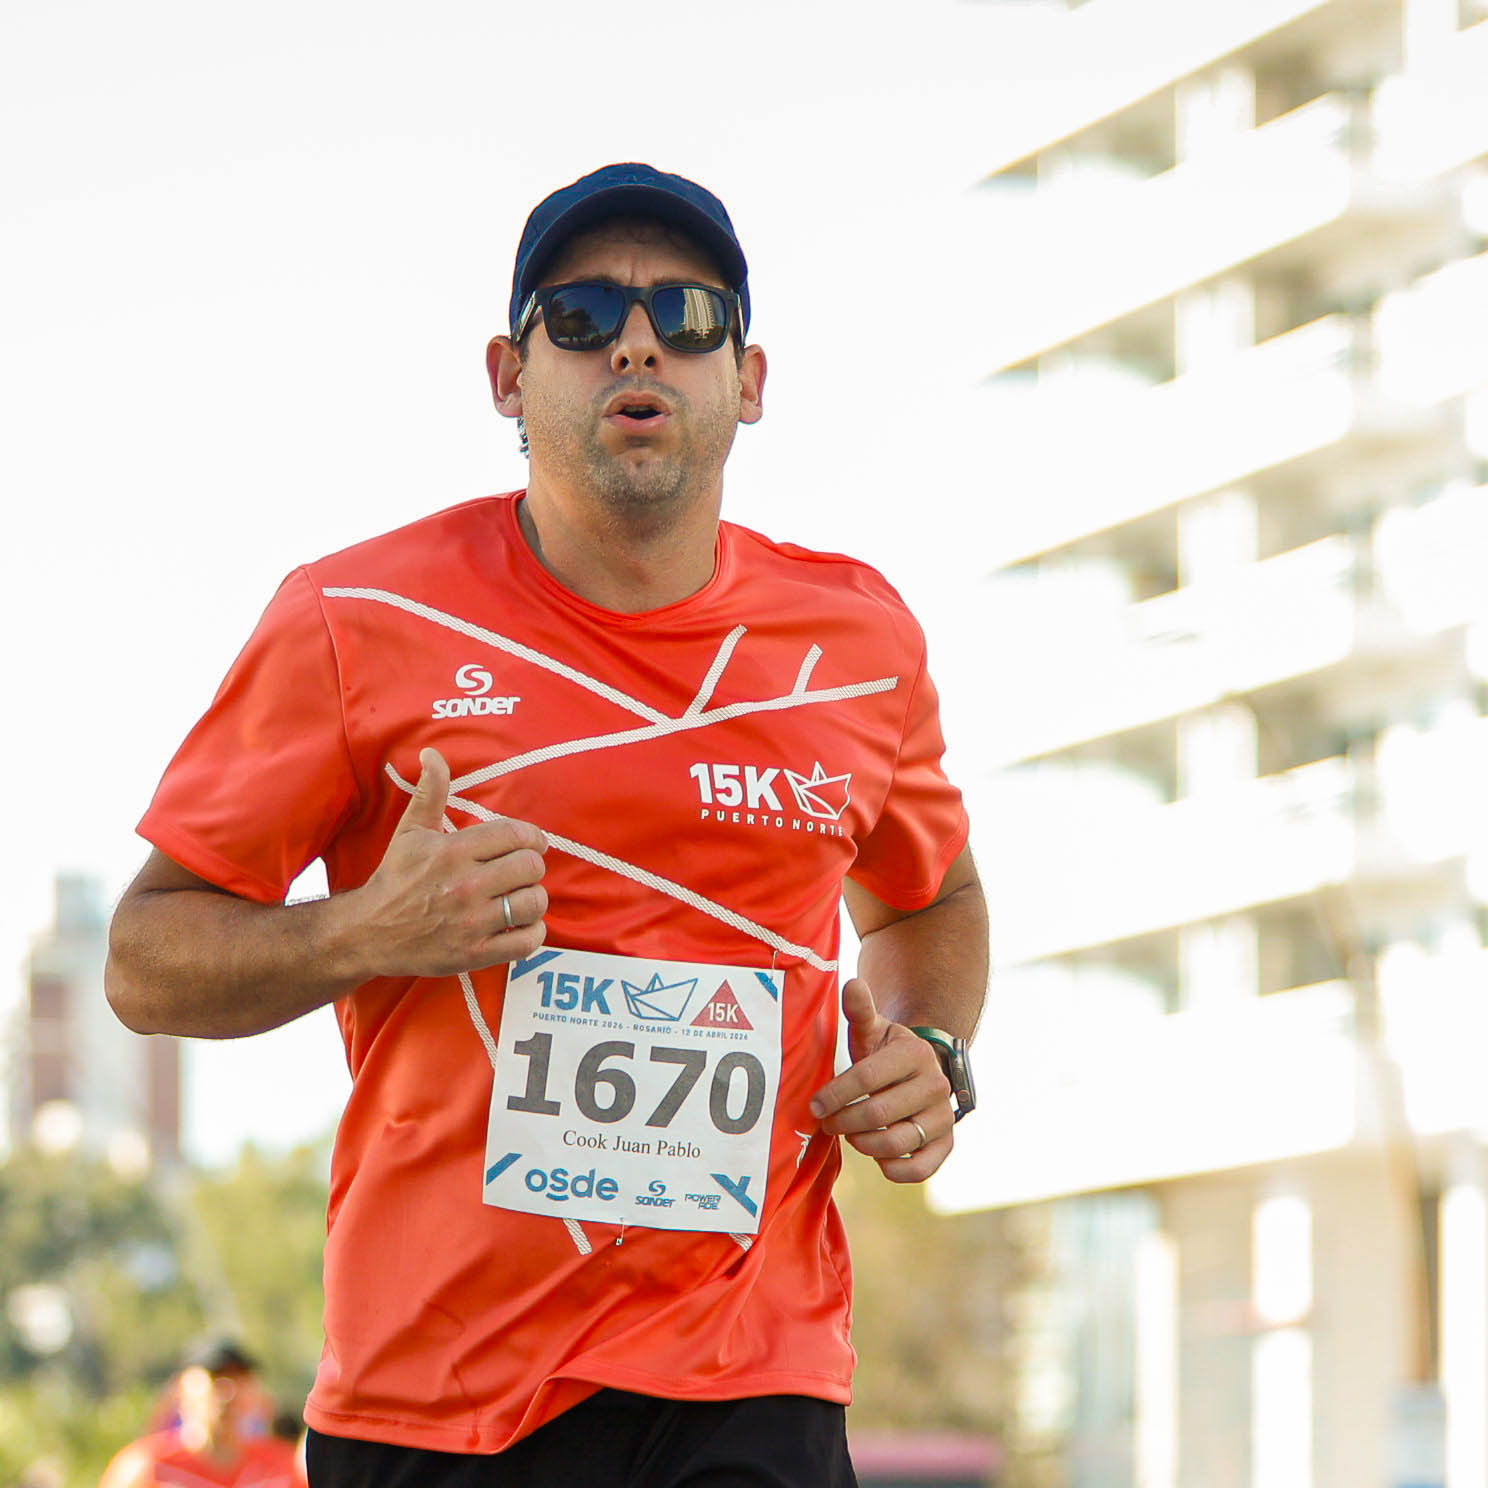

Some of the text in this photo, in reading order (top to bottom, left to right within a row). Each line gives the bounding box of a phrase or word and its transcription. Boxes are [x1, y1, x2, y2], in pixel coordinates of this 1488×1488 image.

[689, 762, 784, 811] 15K
[700, 808, 844, 837] PUERTO NORTE
[536, 970, 615, 1015] 15K
[532, 1011, 567, 1023] PUERTO
[569, 1016, 599, 1027] NORTE
[601, 1020, 624, 1030] 2026
[633, 1023, 672, 1034] ROSARIO
[681, 1028, 691, 1037] 12
[706, 1031, 727, 1039] ABRIL
[707, 1001, 738, 1023] 15K
[506, 1031, 767, 1136] 1670
[562, 1129, 701, 1159] Cook Juan Pablo
[524, 1166, 619, 1202] osde
